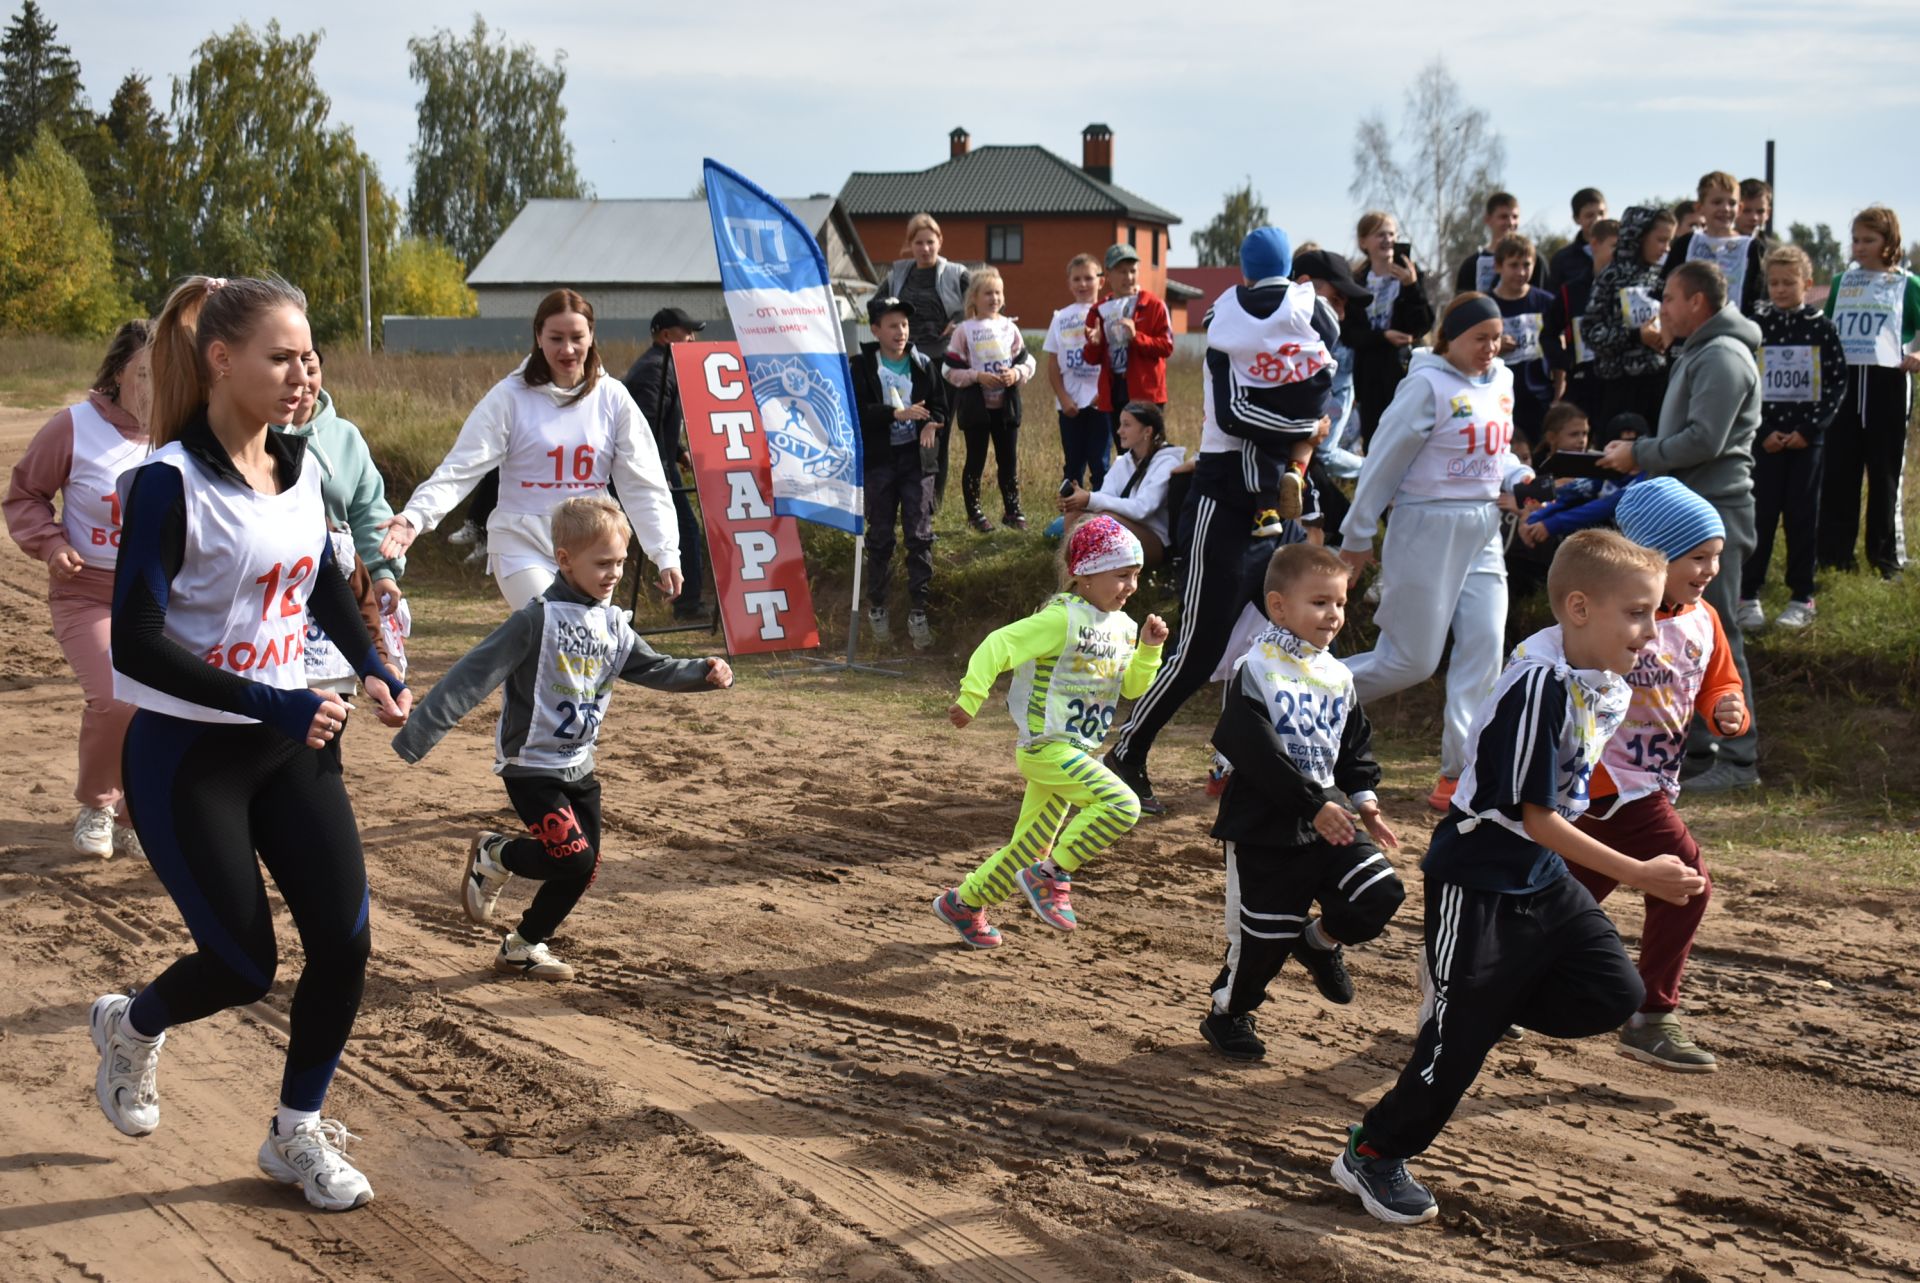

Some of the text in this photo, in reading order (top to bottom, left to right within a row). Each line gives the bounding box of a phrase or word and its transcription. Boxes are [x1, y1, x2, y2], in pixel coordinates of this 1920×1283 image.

[1836, 311, 1888, 336] 1707
[1765, 370, 1809, 388] 10304
[547, 444, 595, 481] 16
[702, 351, 790, 641] СТАРТ
[256, 556, 313, 621] 12
[1075, 640, 1117, 659] НАЦИИ
[1625, 668, 1674, 688] АЦИИ
